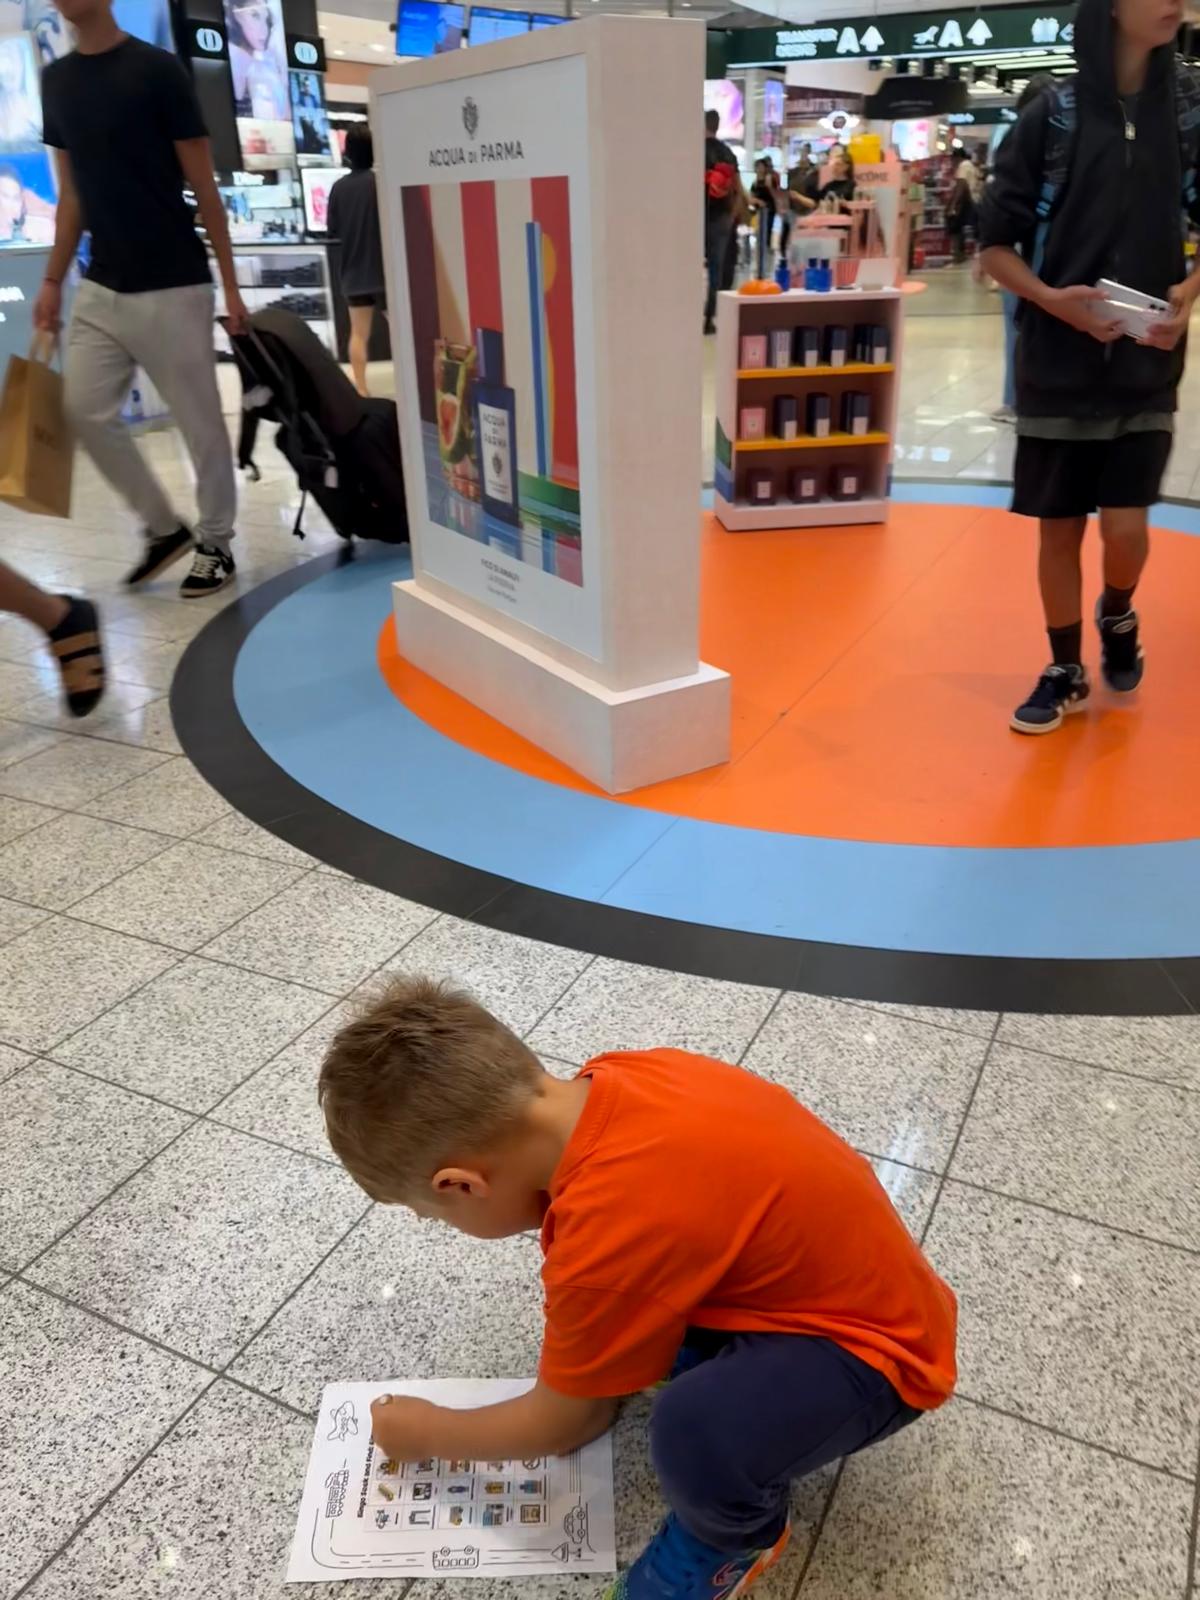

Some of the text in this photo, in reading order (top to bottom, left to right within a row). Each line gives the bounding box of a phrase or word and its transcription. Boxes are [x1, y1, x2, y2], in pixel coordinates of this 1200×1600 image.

[836, 26, 860, 54] A
[938, 19, 964, 48] A
[429, 147, 466, 167] ACQUA
[481, 140, 525, 162] PARMA
